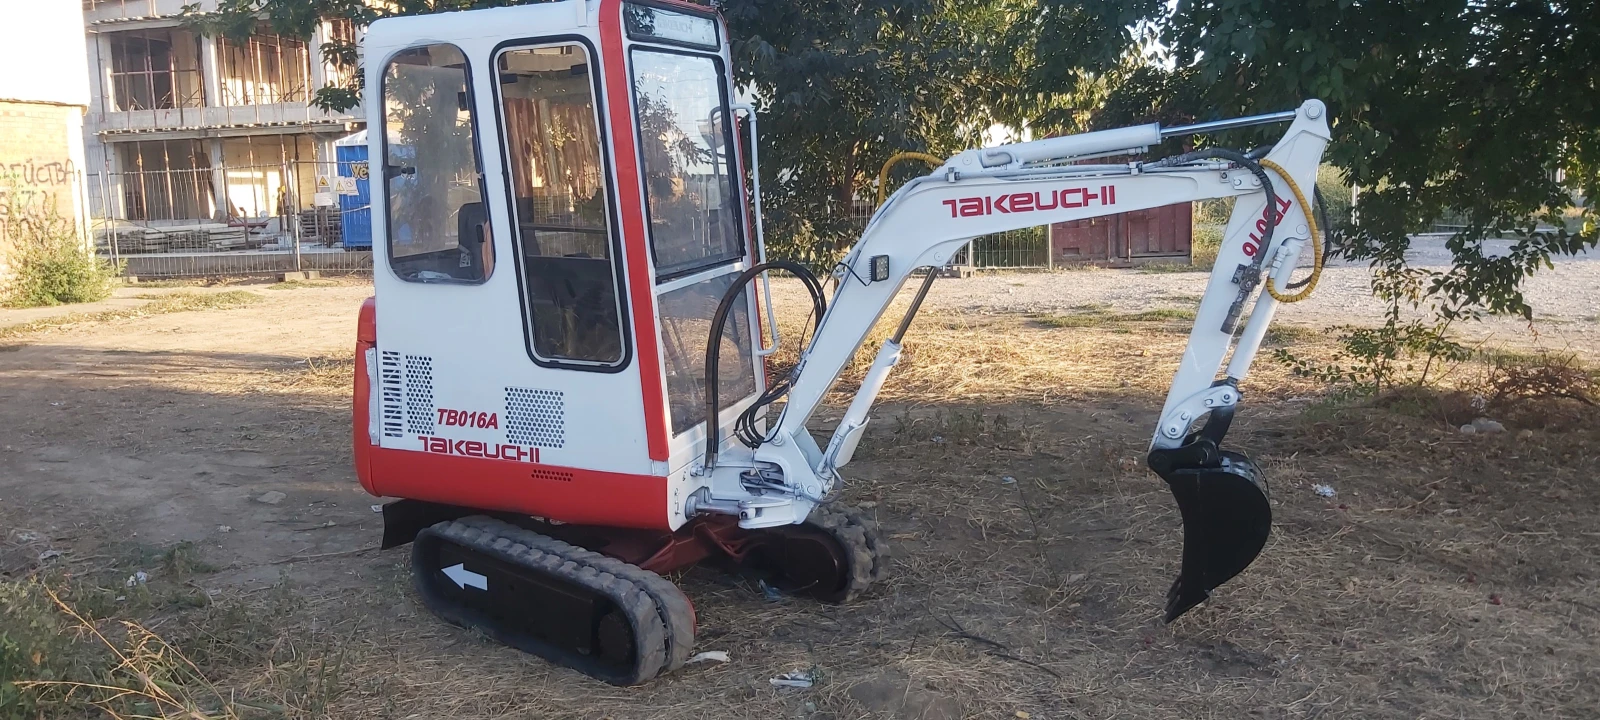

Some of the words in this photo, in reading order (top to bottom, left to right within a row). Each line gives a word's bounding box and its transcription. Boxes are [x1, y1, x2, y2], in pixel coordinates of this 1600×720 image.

[942, 185, 1116, 218] TAKEUCHI
[437, 408, 499, 430] TB016A
[417, 435, 540, 464] TAKEUCHI
